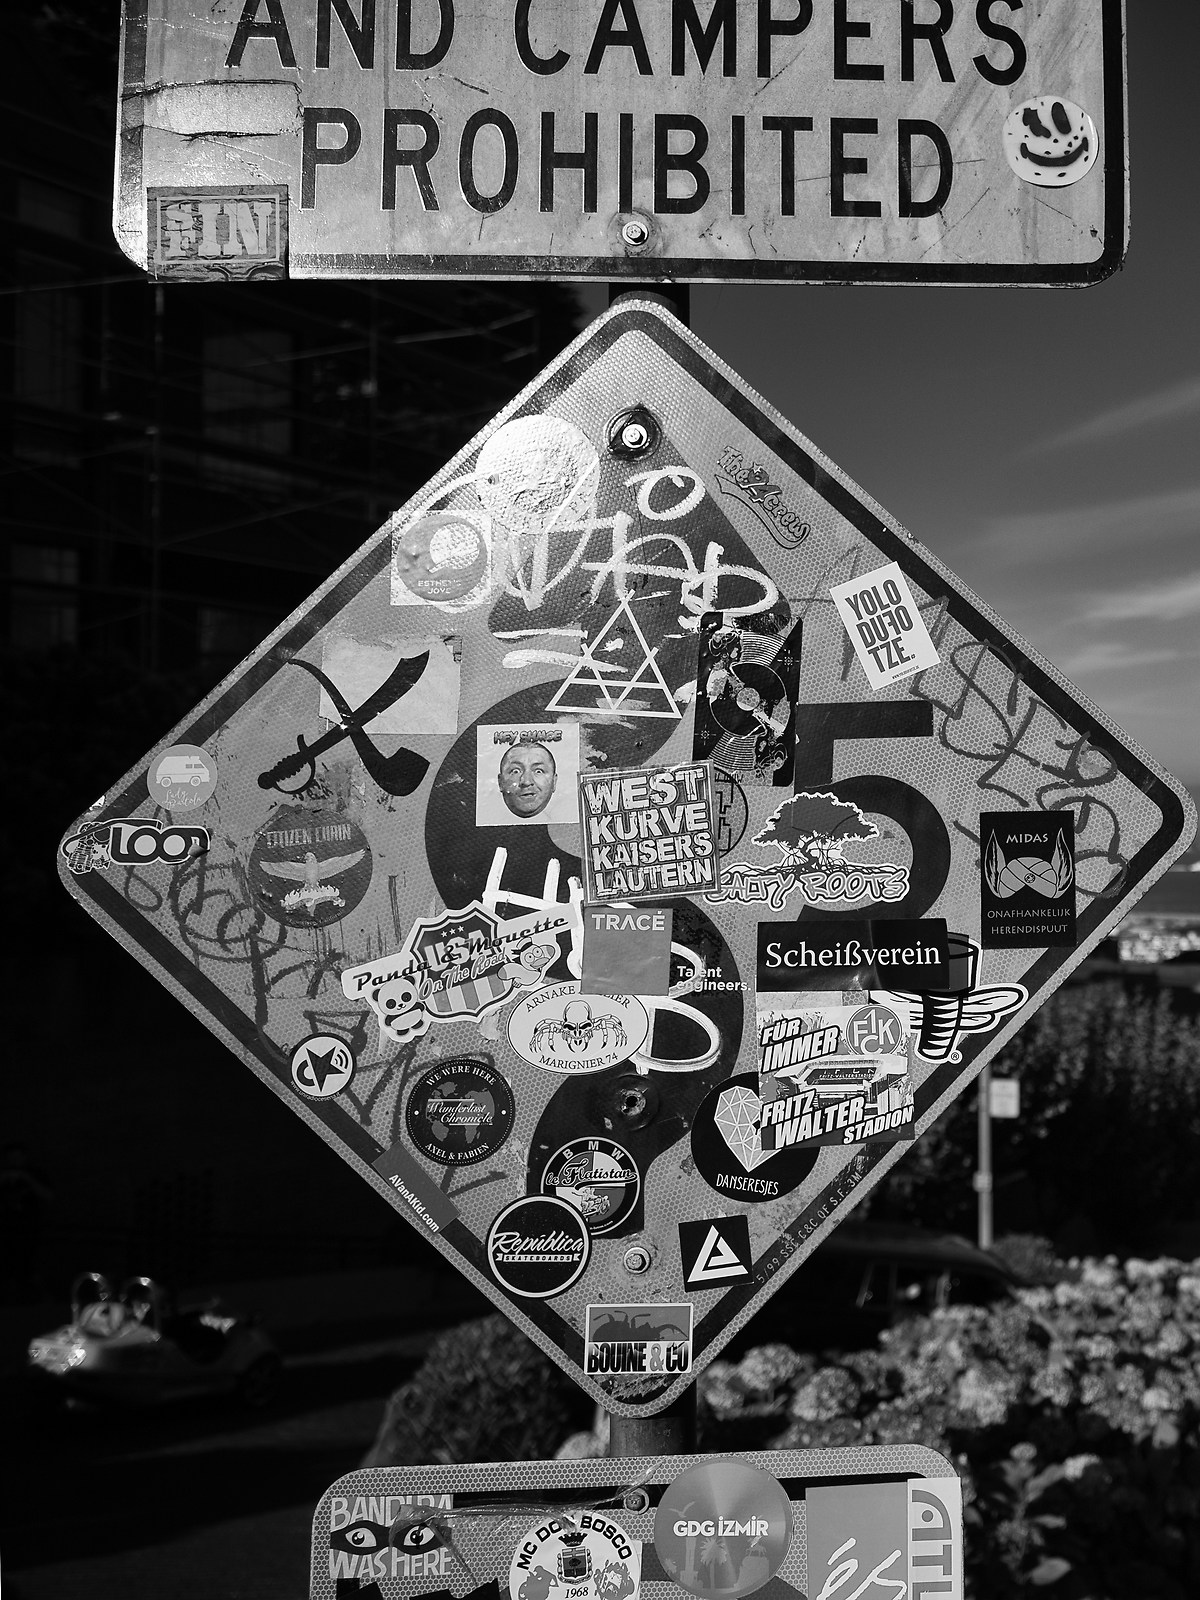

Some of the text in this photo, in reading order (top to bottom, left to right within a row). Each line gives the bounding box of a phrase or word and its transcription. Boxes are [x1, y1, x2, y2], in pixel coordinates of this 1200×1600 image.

[225, 0, 1028, 86] AND CAMPERS
[300, 107, 954, 219] PROHIBITED
[718, 445, 750, 484] The
[845, 579, 902, 621] YOLO
[494, 730, 518, 745] HEY
[585, 767, 705, 815] WEST
[589, 802, 709, 845] KURVE
[1006, 833, 1049, 844] MIDAS
[591, 832, 713, 872] KAISERS
[595, 858, 713, 897] LAUTERN
[707, 869, 907, 908] SALTY ROOTS
[987, 908, 1071, 919] ONAFHANKELIJK
[991, 924, 1068, 935] HERENDISPUUT
[353, 957, 432, 992] Panda
[464, 917, 569, 955] Mouette
[766, 940, 942, 968] Scheißverein
[418, 946, 507, 1000] On The Road
[676, 965, 722, 978] Taent
[526, 985, 576, 1013] ARNAKE
[761, 1018, 801, 1046] FÜR
[538, 1052, 619, 1070] MARIGNIER 74
[762, 1026, 840, 1073] IMMER
[426, 1065, 497, 1086] WE WERE HERE
[427, 1101, 487, 1113] Wanderlust
[441, 1111, 494, 1123] Chronicle
[761, 1089, 816, 1128] FRITZ
[775, 1096, 866, 1150] WALTER
[843, 1105, 915, 1145] STADION
[425, 1142, 490, 1160] AXEL & FABIEN
[715, 1173, 779, 1196] DANSERESJES
[388, 1174, 440, 1233] AVanAKid.com
[492, 1230, 585, 1255] República
[650, 1343, 664, 1372] &
[517, 1515, 633, 1570] MC DO BOSCO
[673, 1520, 715, 1537] GDG
[329, 1547, 452, 1578] WAS HERE
[565, 1586, 589, 1598] 1968
